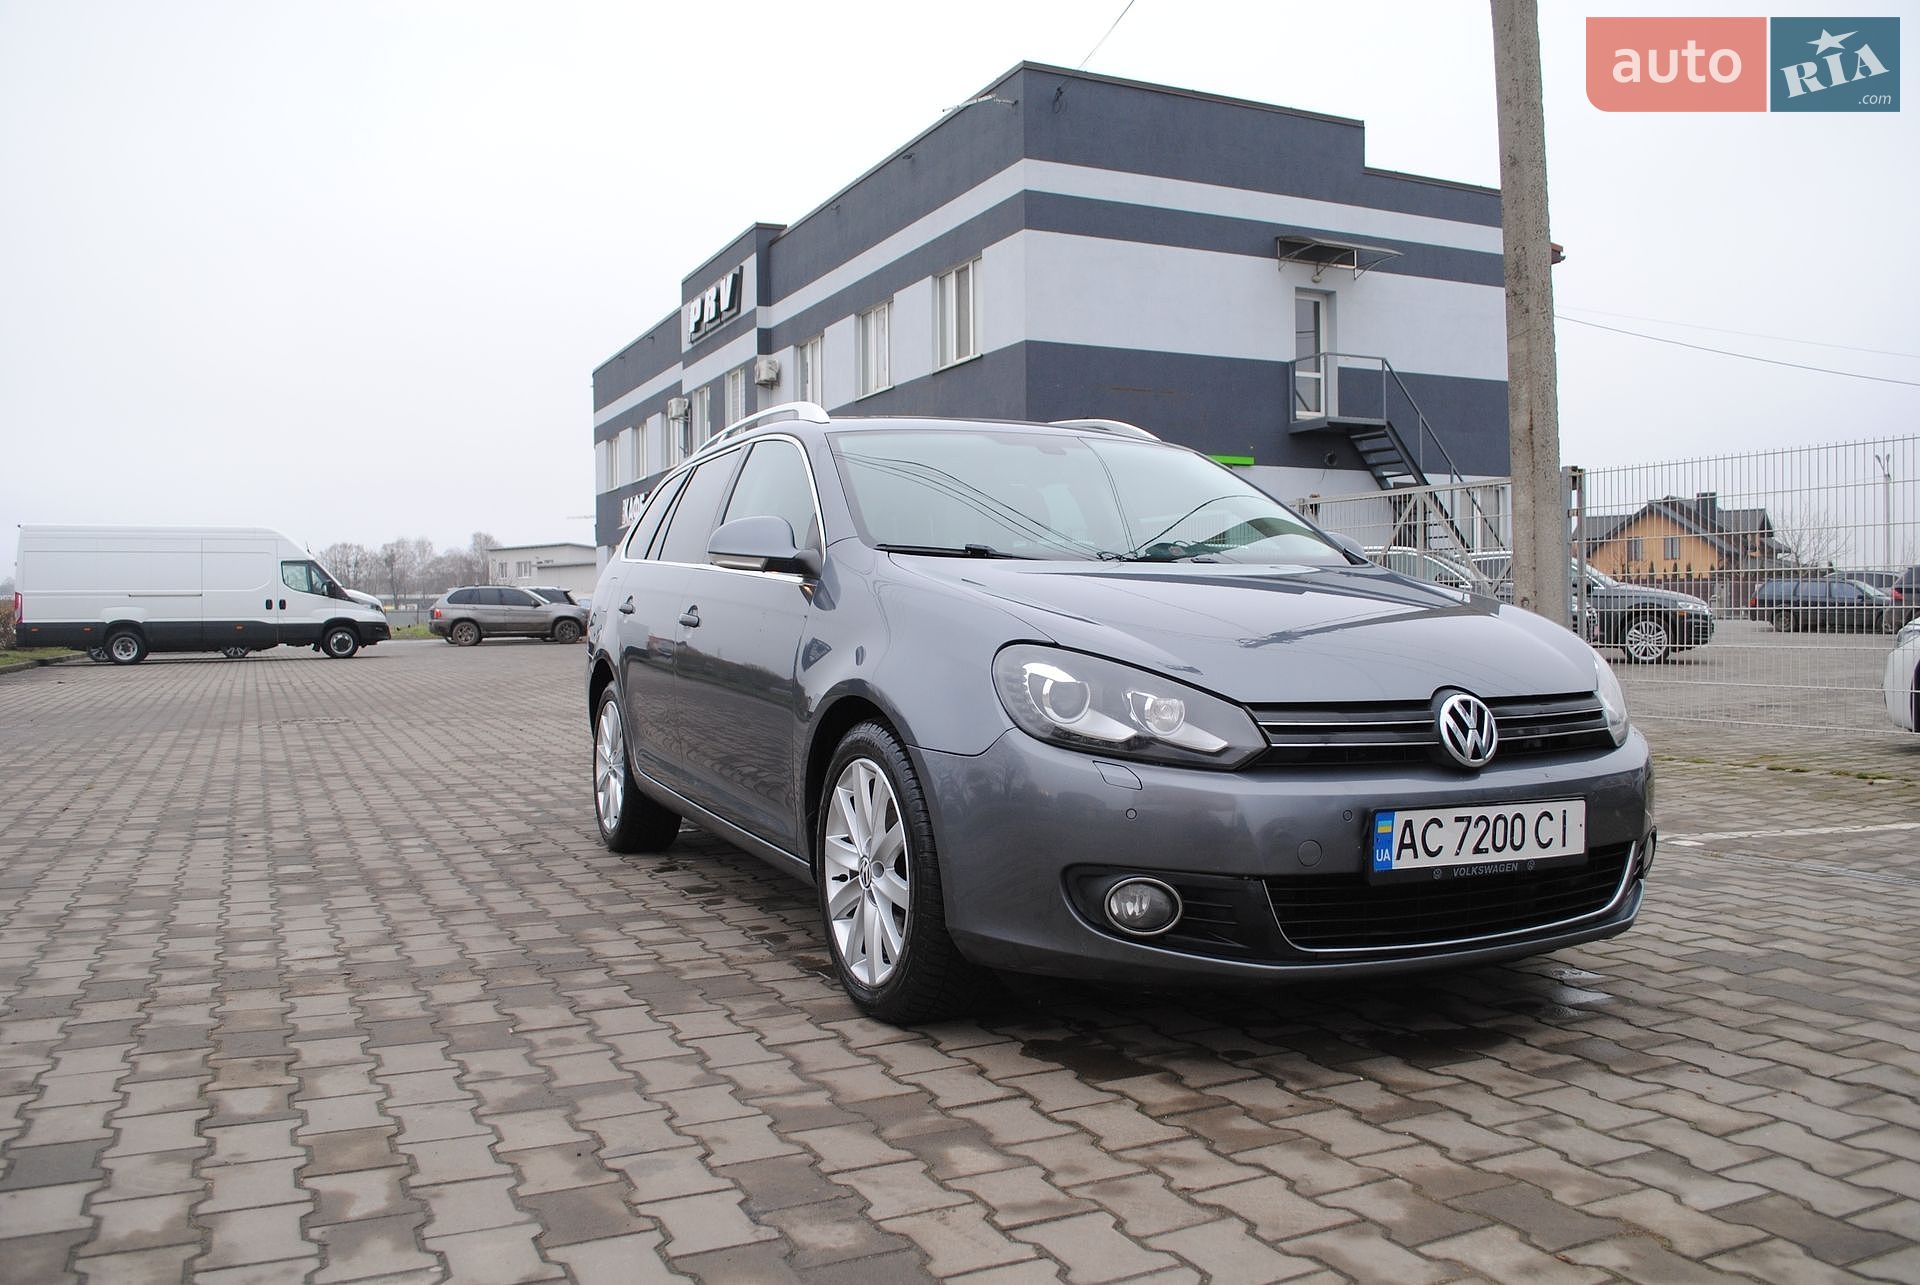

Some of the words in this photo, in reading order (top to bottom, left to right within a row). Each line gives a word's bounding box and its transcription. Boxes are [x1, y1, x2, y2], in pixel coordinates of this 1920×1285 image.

[689, 271, 740, 334] PRV
[1396, 818, 1444, 861] AC
[1454, 812, 1526, 857] 7200
[1534, 809, 1567, 849] CI
[1376, 849, 1391, 862] UA
[1453, 862, 1519, 877] VOLKSWAGEN
